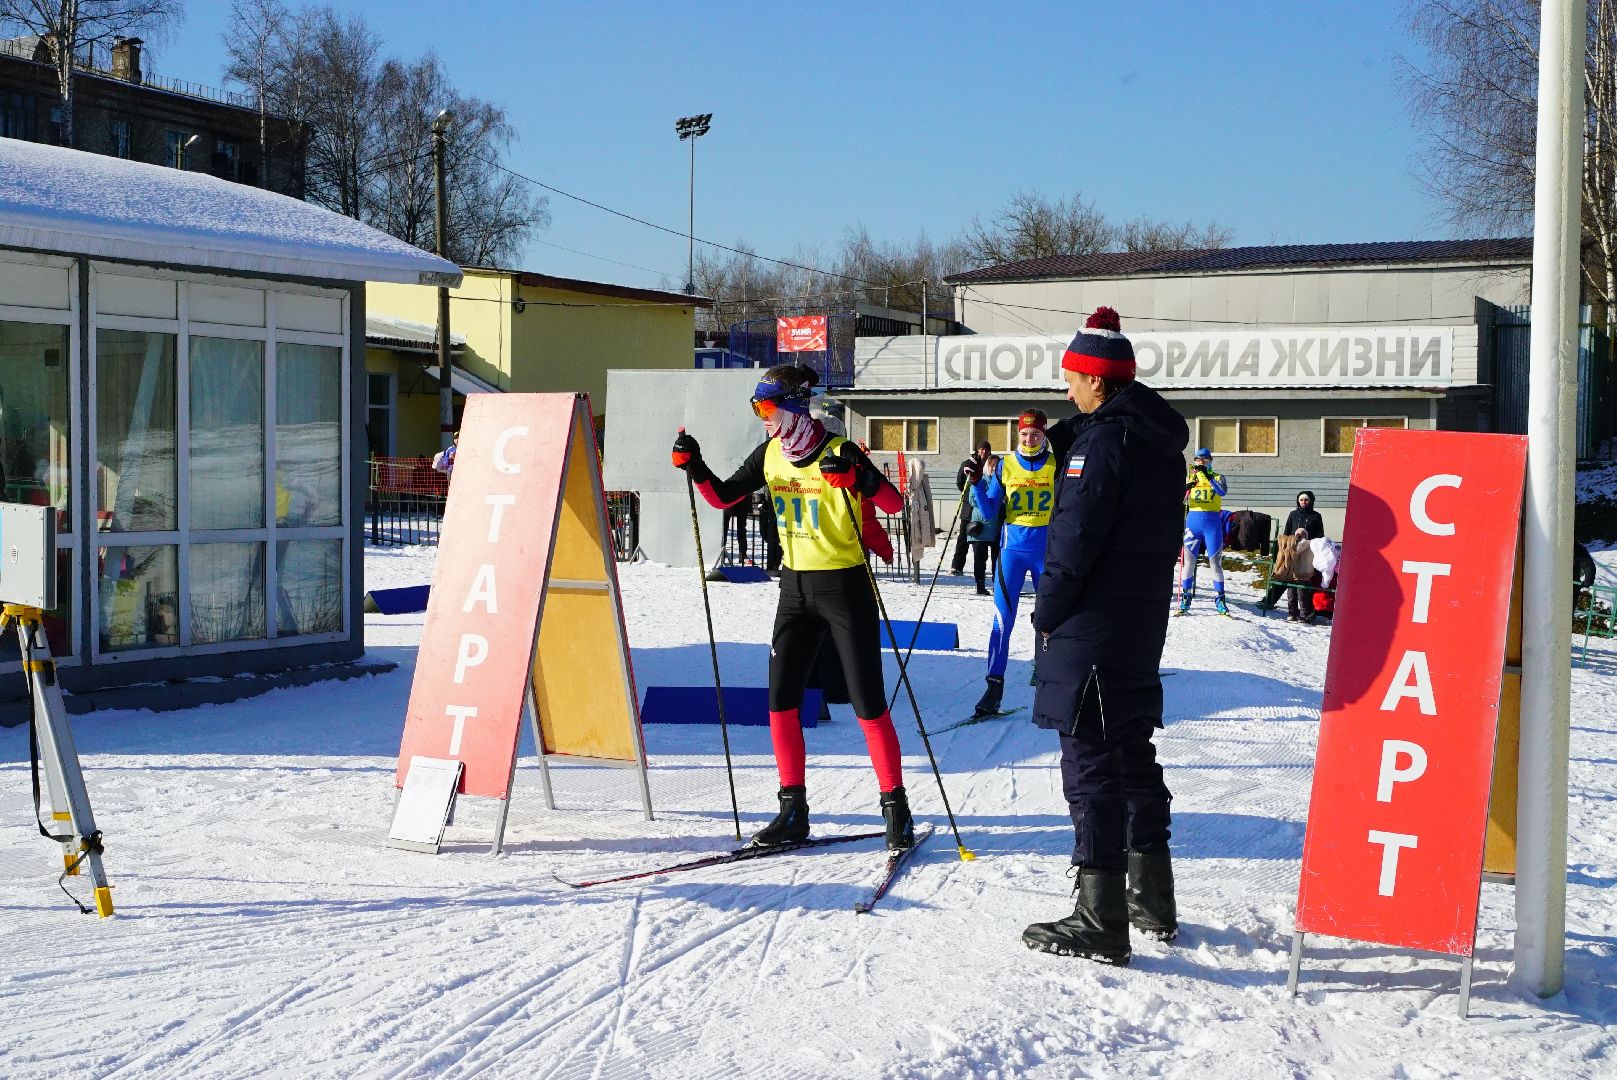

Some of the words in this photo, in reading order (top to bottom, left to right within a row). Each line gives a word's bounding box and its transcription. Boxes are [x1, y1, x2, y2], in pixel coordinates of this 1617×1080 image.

[945, 343, 1066, 381] СПОРТ
[1134, 338, 1260, 378] ОРМА
[1268, 337, 1441, 377] ЖИЗНИ
[774, 495, 820, 530] 211
[1010, 490, 1052, 512] 212
[1195, 489, 1216, 501] 217
[446, 426, 528, 756] СТАРТ
[1368, 474, 1463, 897] СТАРТ
